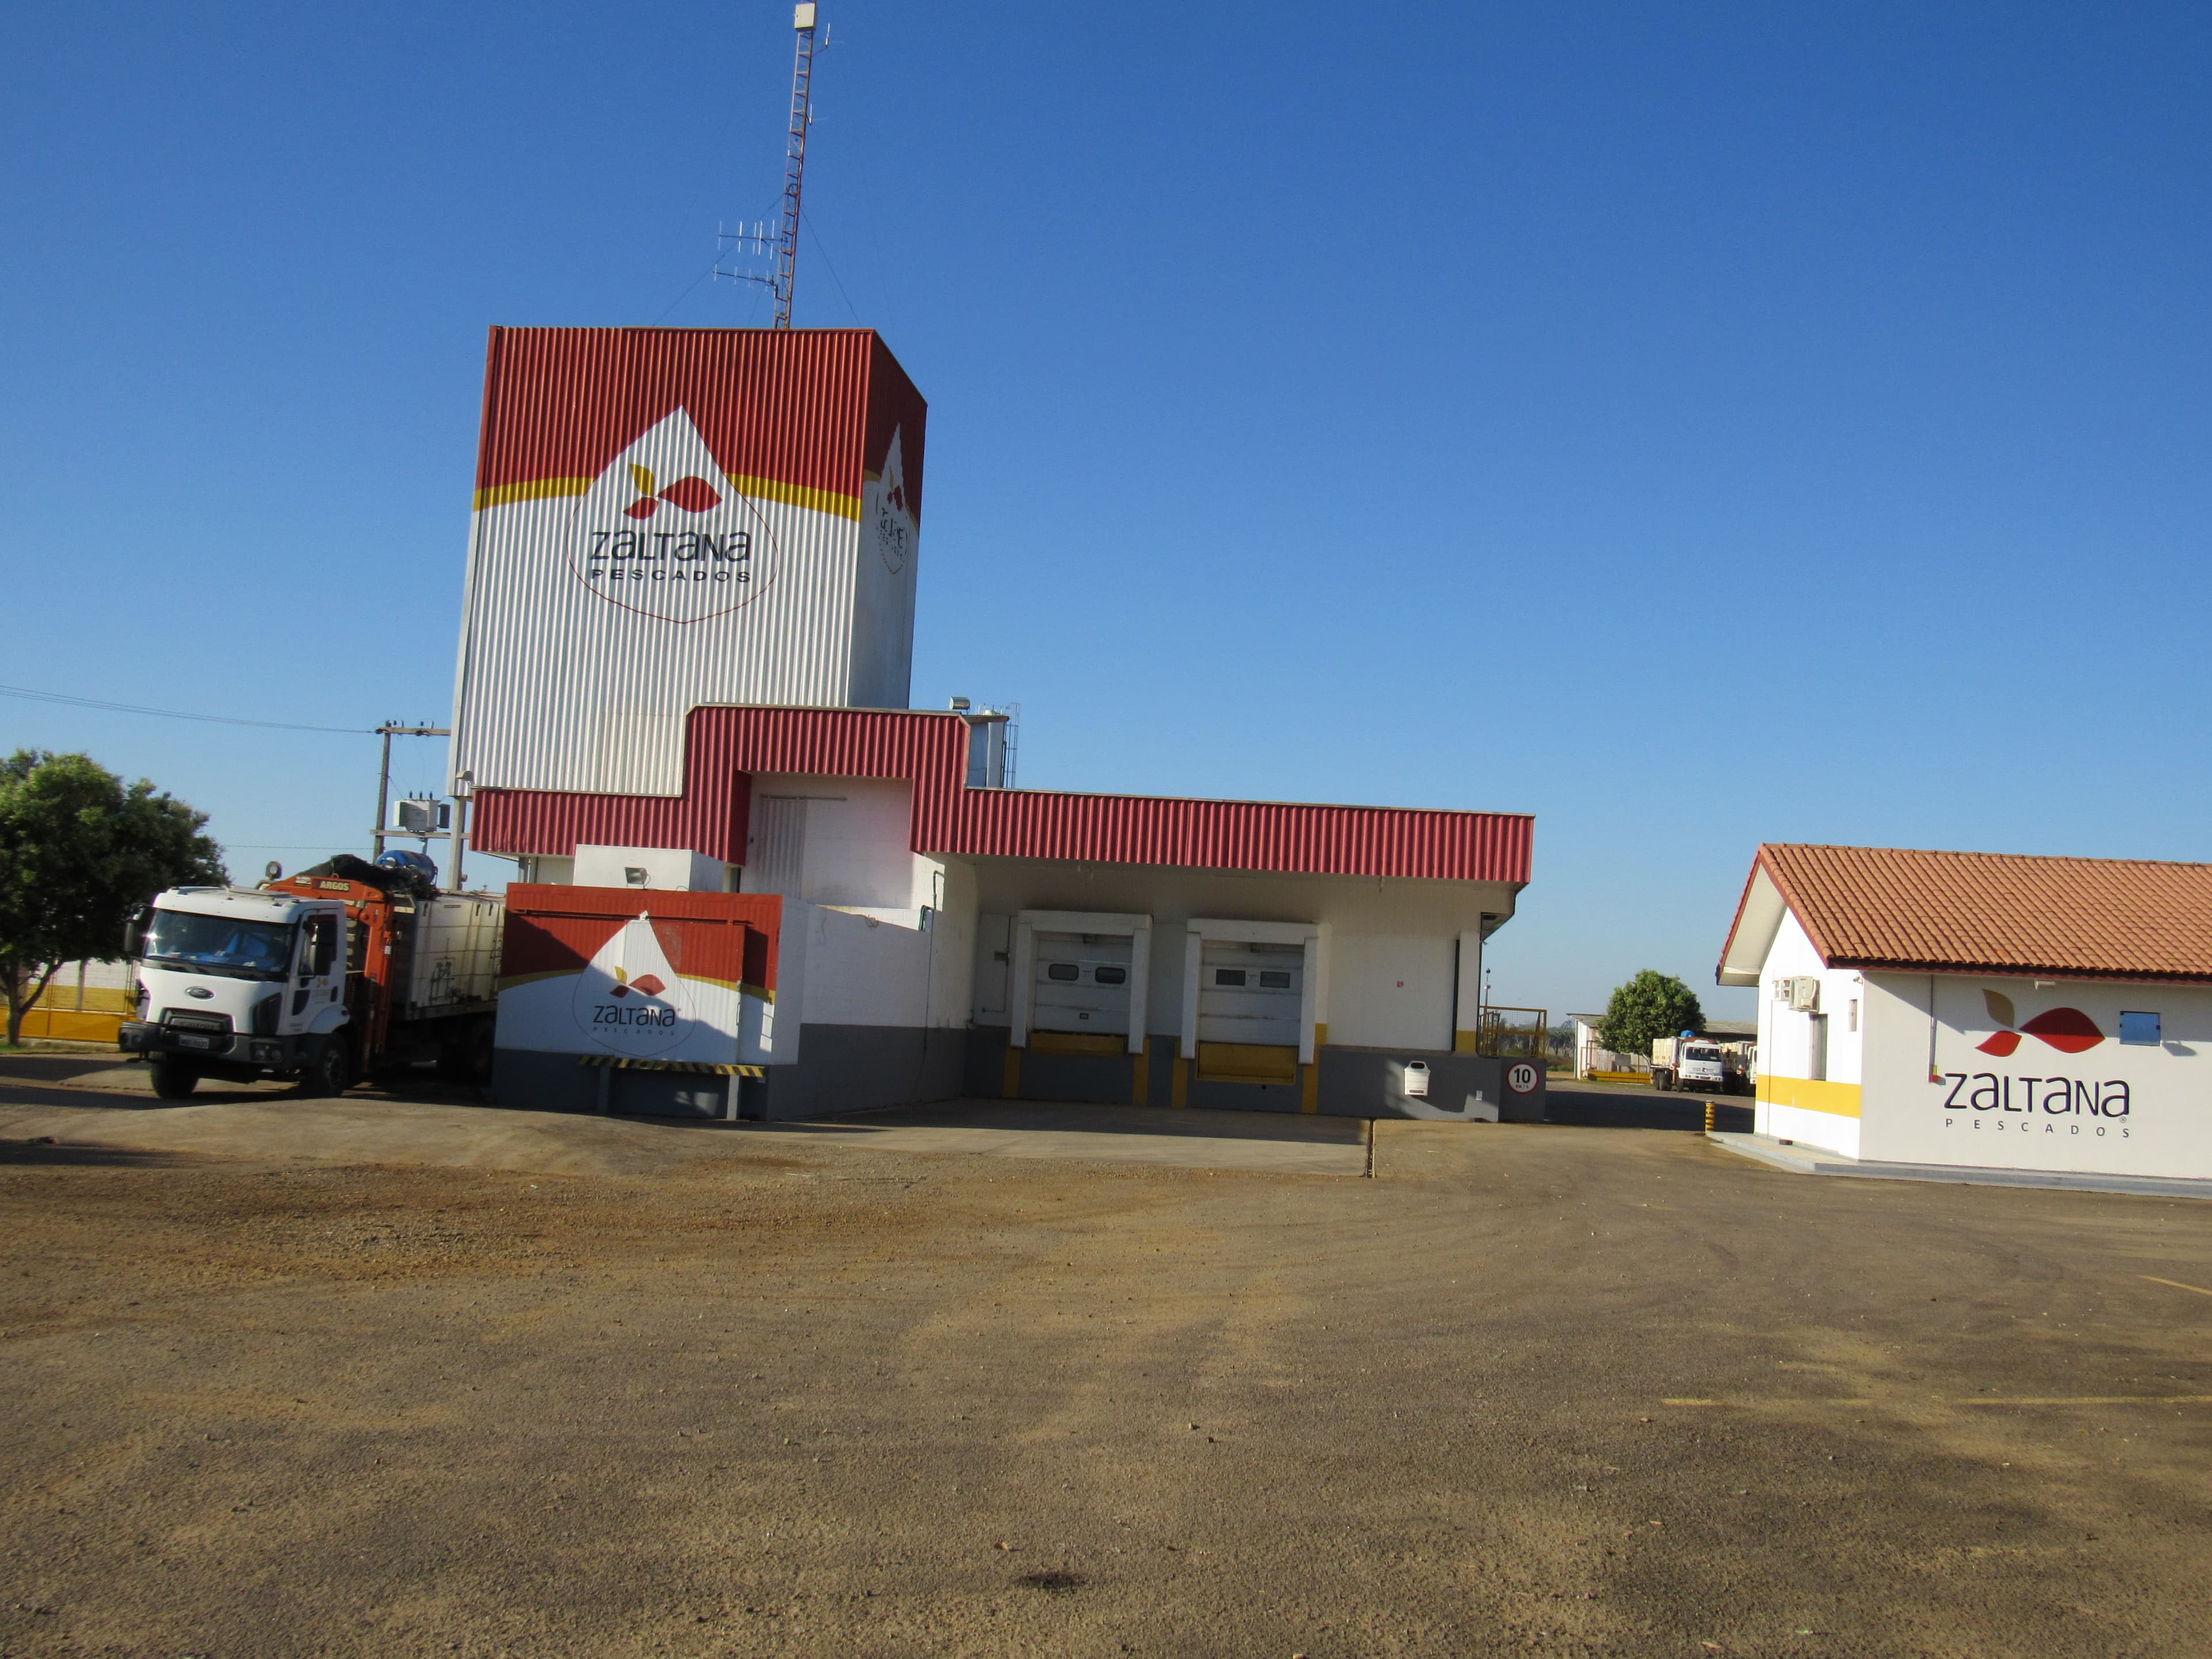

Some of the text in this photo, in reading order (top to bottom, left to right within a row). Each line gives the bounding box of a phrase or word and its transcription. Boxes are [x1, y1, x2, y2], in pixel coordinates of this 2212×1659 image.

[591, 569, 751, 583] PESCADOS
[320, 880, 350, 892] ARGOS
[593, 1026, 675, 1036] PESCADOS
[1514, 1068, 1531, 1084] 10
[1945, 1118, 2130, 1138] PESCADOS
